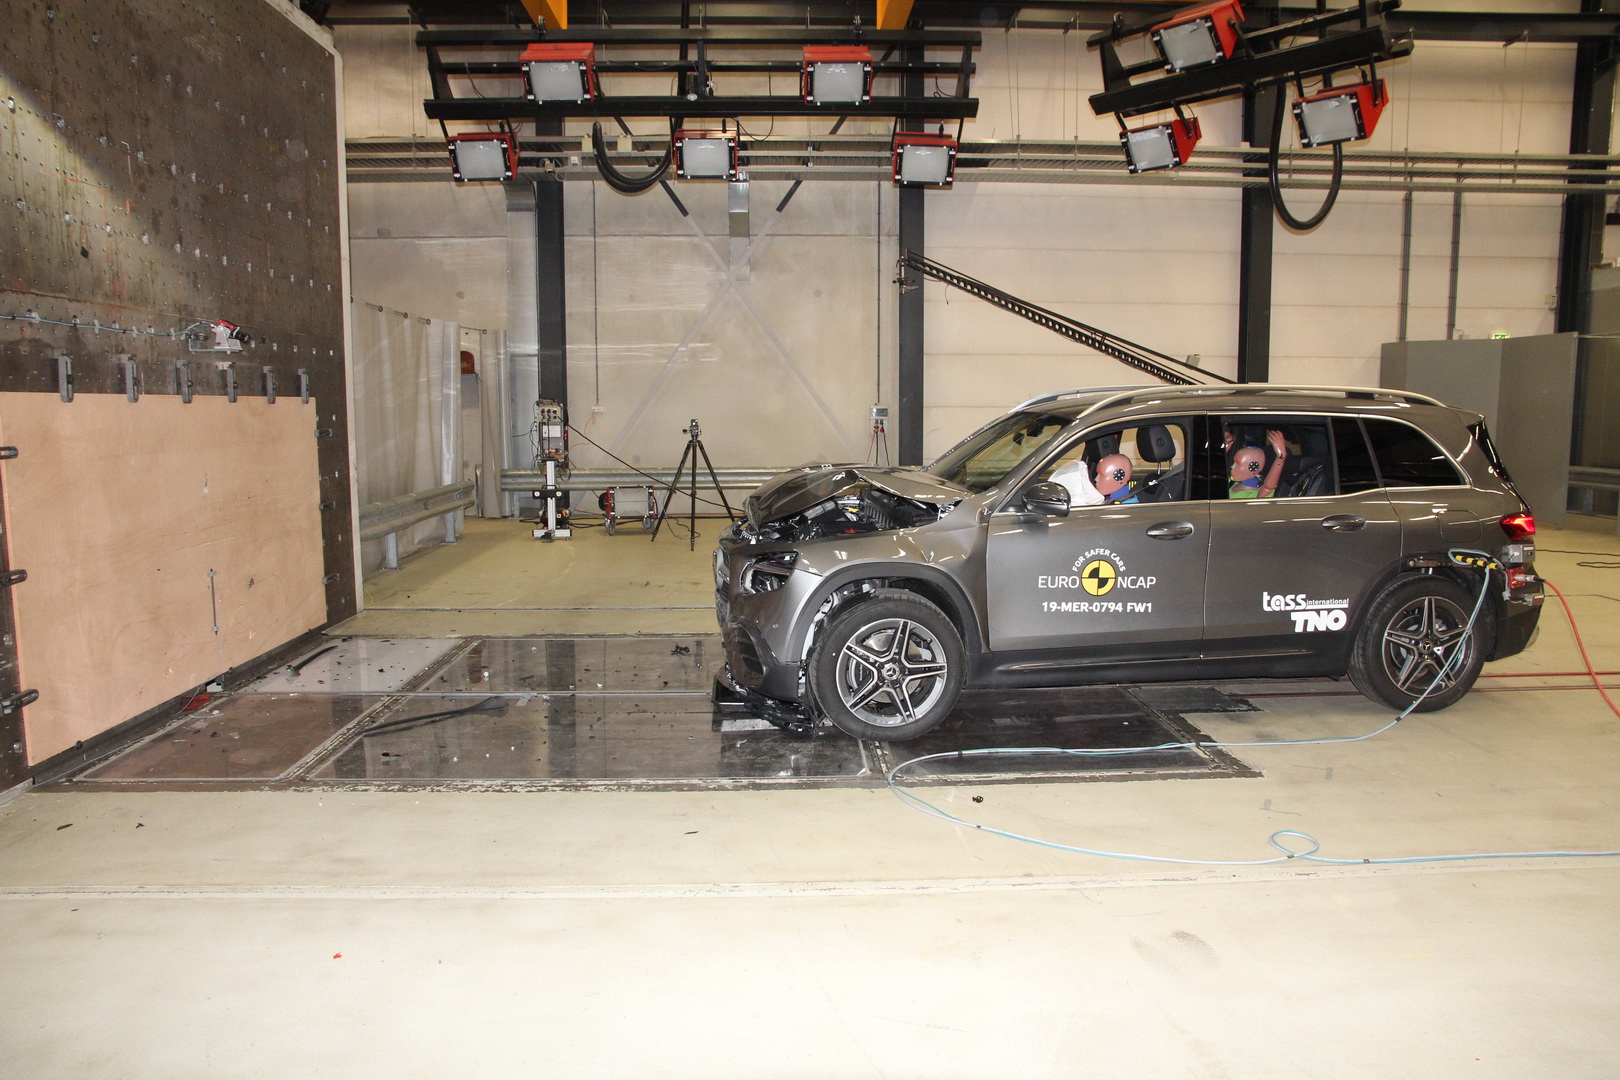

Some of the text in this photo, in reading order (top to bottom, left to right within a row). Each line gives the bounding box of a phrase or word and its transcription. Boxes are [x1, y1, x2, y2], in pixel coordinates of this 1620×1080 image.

[1072, 548, 1126, 572] FOR SAFER CARS
[1038, 575, 1156, 588] EURO NCAP
[1042, 601, 1152, 613] 19-MER-0794 FW1
[1262, 591, 1349, 611] tass international
[1290, 609, 1347, 633] TNO
